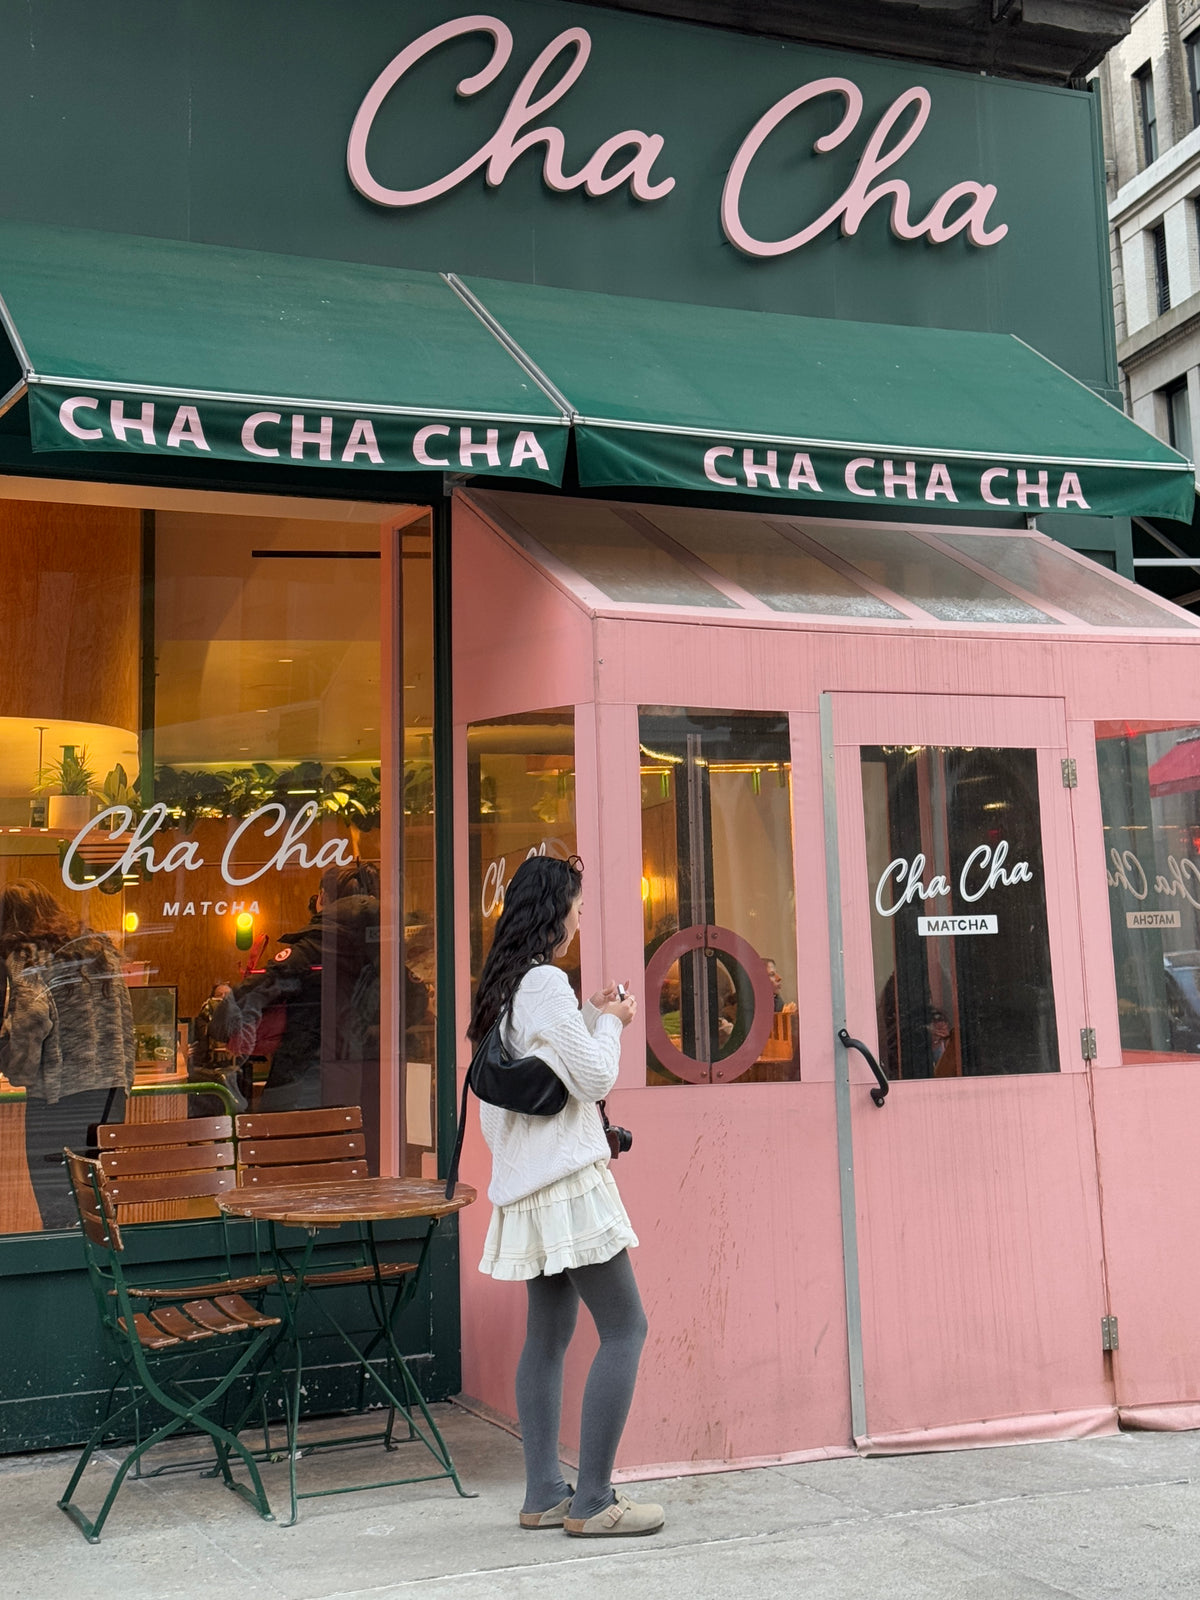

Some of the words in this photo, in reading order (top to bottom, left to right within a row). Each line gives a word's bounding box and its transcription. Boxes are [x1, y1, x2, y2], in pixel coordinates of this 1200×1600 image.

[347, 15, 674, 206] Cha
[722, 77, 1009, 257] Cha
[58, 396, 211, 451] CHA
[240, 411, 385, 464] CHA
[412, 423, 551, 471] CHA
[703, 445, 824, 493] CHA
[844, 457, 960, 503] CHA
[980, 467, 1092, 510] CHA
[62, 803, 203, 891] Cha
[221, 801, 353, 886] Cha
[875, 853, 951, 917] Cha
[959, 840, 1033, 902] Cha
[163, 901, 261, 917] MATCHA
[926, 918, 989, 932] MATCHA
